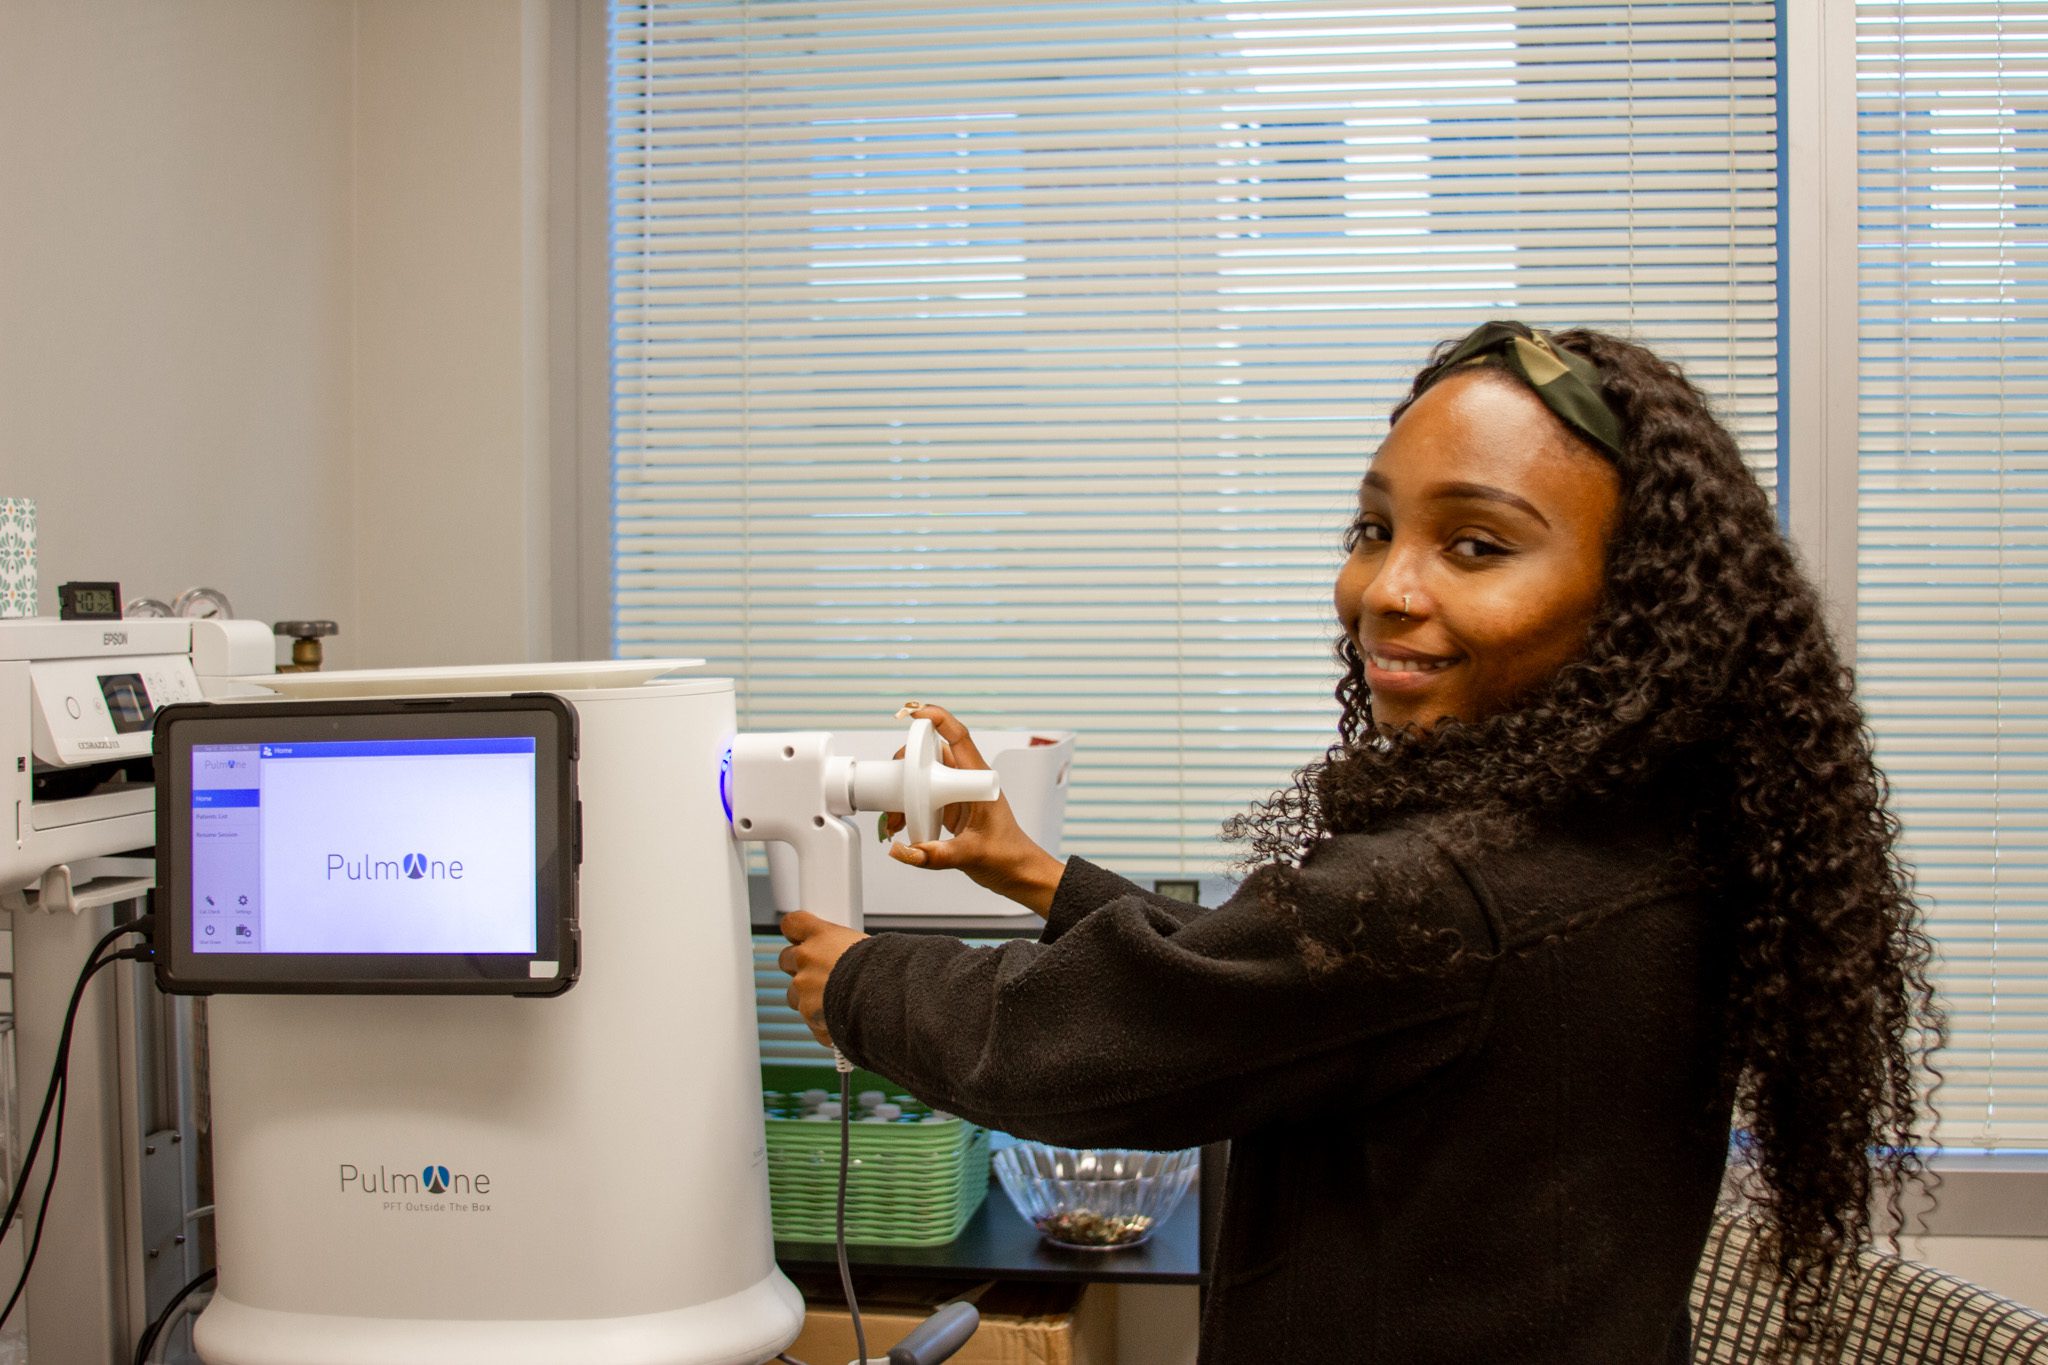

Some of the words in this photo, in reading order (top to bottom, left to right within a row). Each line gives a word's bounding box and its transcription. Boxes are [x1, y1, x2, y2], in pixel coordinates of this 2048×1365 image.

[103, 632, 128, 646] EPSON
[383, 1202, 402, 1212] PFT
[405, 1202, 446, 1212] Outside
[450, 1203, 469, 1212] The
[472, 1203, 491, 1212] Box
